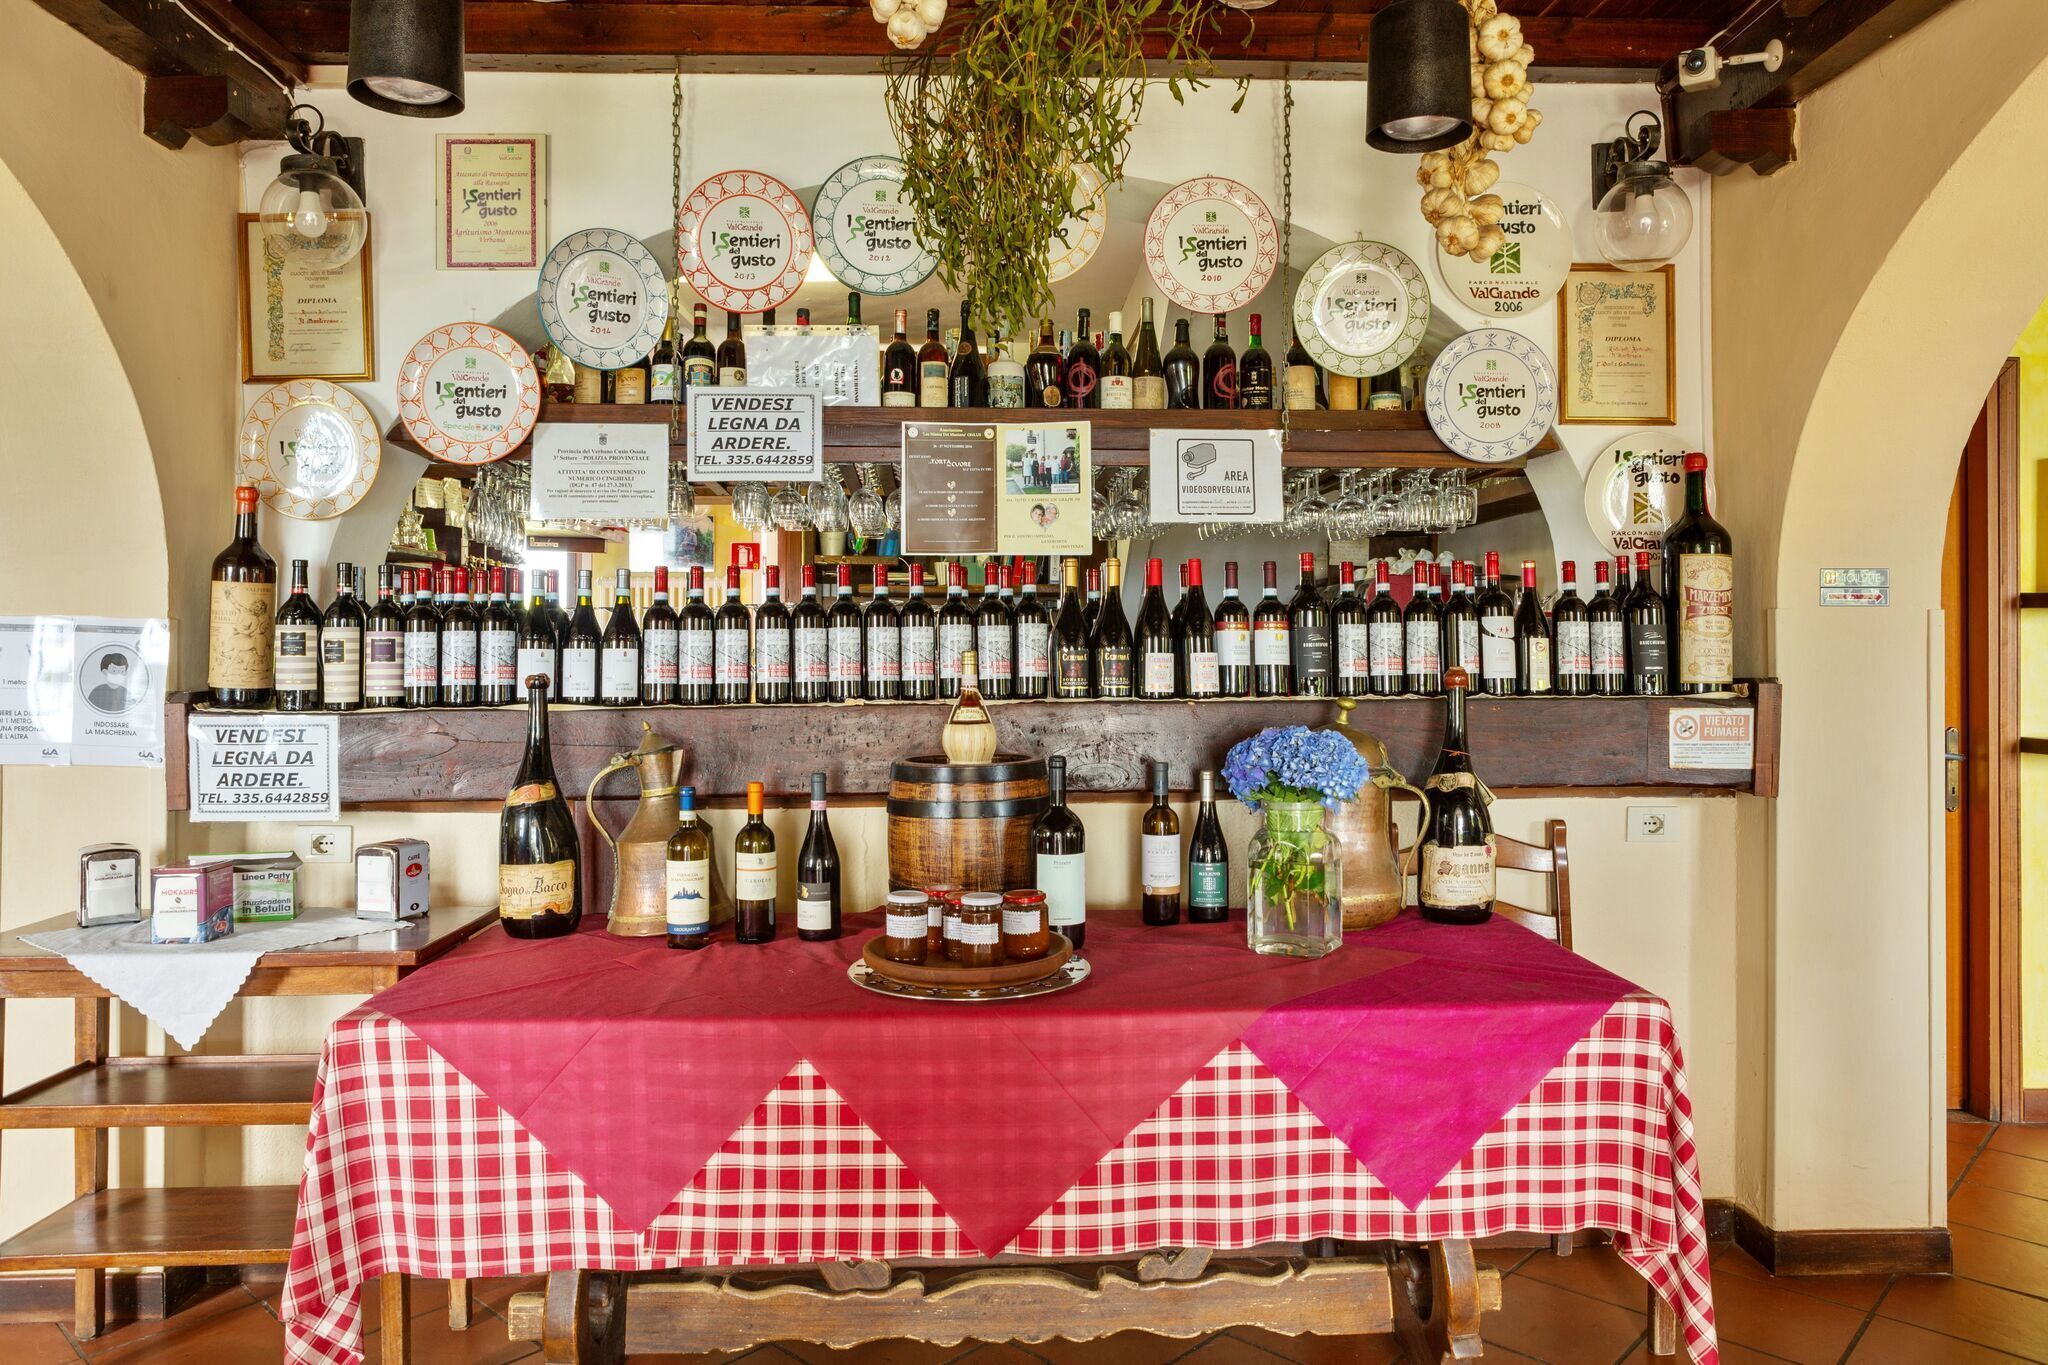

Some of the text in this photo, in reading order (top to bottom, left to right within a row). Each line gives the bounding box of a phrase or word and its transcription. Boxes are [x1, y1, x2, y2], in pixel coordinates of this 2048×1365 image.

[463, 188, 521, 206] Sentieri
[479, 206, 517, 219] gusto
[847, 216, 916, 237] Sentieri
[1498, 221, 1535, 234] usto
[453, 229, 492, 238] Agriturismo
[713, 233, 780, 254] Sentieri
[866, 237, 911, 251] gusto
[1179, 236, 1247, 257] Sentieri
[731, 255, 776, 269] gusto
[1199, 256, 1243, 271] gusto
[587, 276, 621, 287] ValGrande
[569, 286, 637, 309] Sentieri
[1470, 287, 1540, 299] ValGrande
[1494, 302, 1522, 312] 2006
[588, 309, 631, 323] gusto
[590, 326, 612, 335] 2014
[1345, 319, 1391, 333] gusto
[452, 374, 490, 382] ValGrande
[436, 383, 507, 404] Sentieri
[1458, 384, 1525, 405] Sentieri
[712, 398, 794, 410] VENDESI
[456, 404, 501, 419] gusto
[1477, 404, 1520, 418] gusto
[708, 418, 800, 430] LEGNA DA
[711, 437, 790, 449] ARDERE.
[696, 455, 813, 465] TEL. 335.6442859
[1632, 465, 1644, 473] del
[1224, 471, 1248, 481] AREA
[1182, 486, 1251, 494] VIDEOSORVEGLIATA
[1705, 716, 1744, 725] VIETATO
[216, 729, 306, 743] VENDESI
[1704, 727, 1745, 736] FUMARE
[212, 751, 314, 765] LEGNA DA
[216, 773, 303, 786] ARDERE.
[200, 793, 329, 803] TEL. 335.6442859
[268, 872, 290, 882] Party
[532, 876, 567, 894] Bacco
[242, 898, 291, 906] Stuzzicadenti
[255, 904, 291, 913] Betulla
